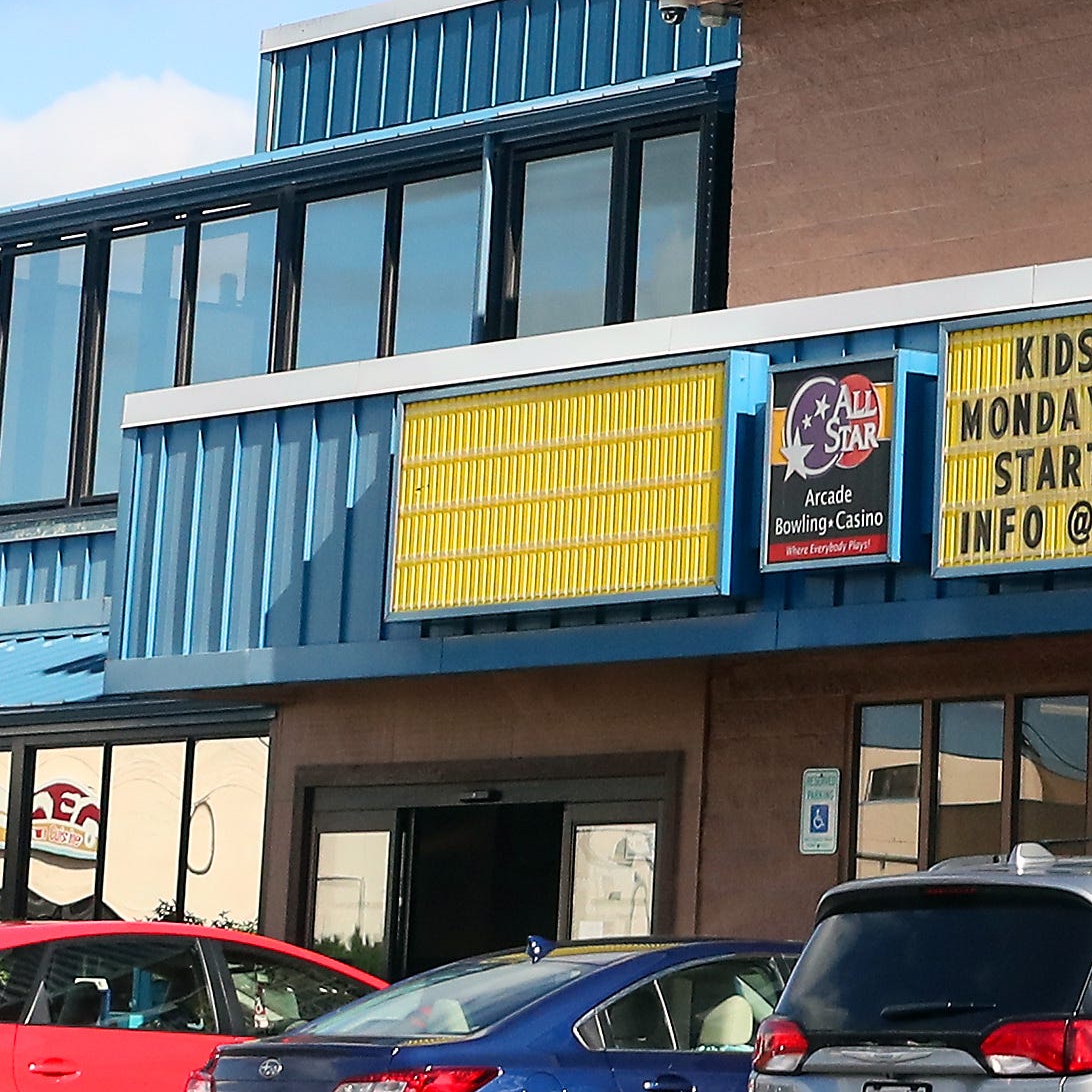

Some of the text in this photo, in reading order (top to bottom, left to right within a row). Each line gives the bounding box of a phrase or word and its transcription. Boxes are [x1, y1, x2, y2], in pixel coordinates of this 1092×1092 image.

[832, 384, 878, 420] ALL
[824, 417, 880, 454] STAR
[804, 484, 853, 507] Arcade
[775, 509, 884, 536] Bowling Casino
[960, 505, 1044, 554] INFO
[785, 538, 871, 557] Where Everybody Plays!
